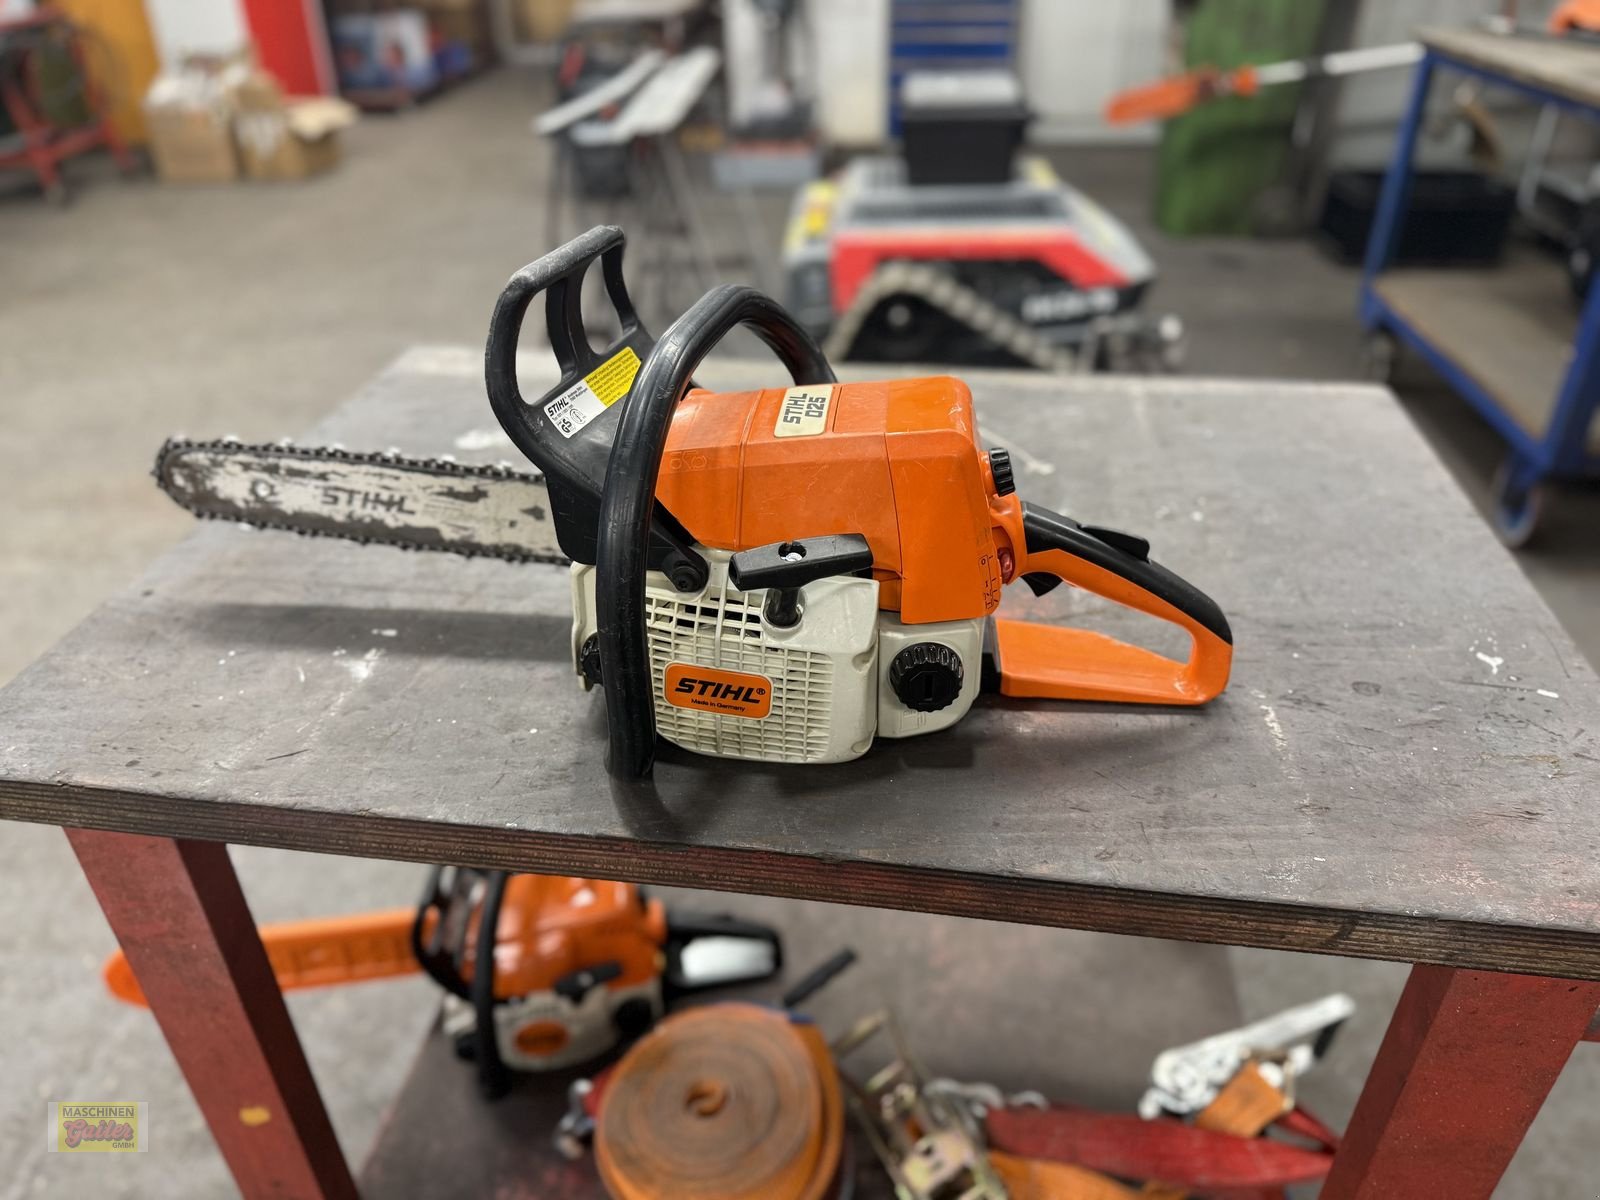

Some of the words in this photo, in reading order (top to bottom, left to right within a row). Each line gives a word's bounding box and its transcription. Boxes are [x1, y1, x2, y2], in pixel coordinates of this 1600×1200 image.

[547, 397, 569, 417] STIHL
[783, 393, 808, 424] STIHL
[321, 487, 415, 515] STIHL
[691, 698, 709, 706] Made
[716, 702, 746, 712] Germany
